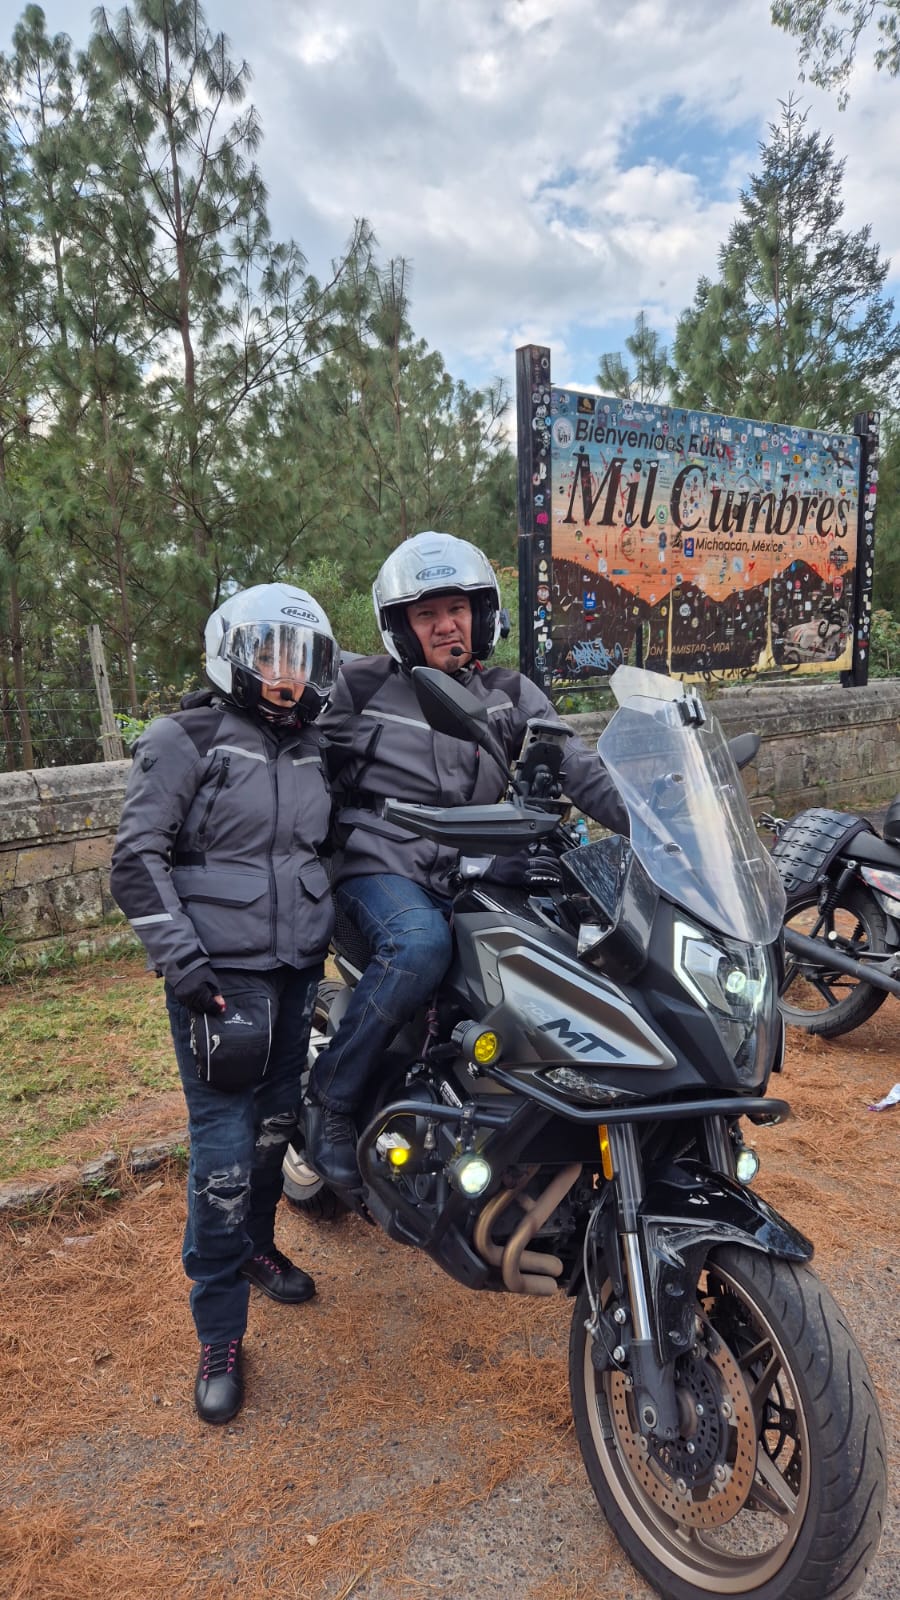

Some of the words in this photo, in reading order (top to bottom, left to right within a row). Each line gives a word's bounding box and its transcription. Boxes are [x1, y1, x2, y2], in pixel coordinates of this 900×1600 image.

[562, 453, 655, 529] Mil
[670, 465, 850, 538] Cumbres
[422, 568, 451, 580] HJC
[537, 1018, 626, 1058] MT
